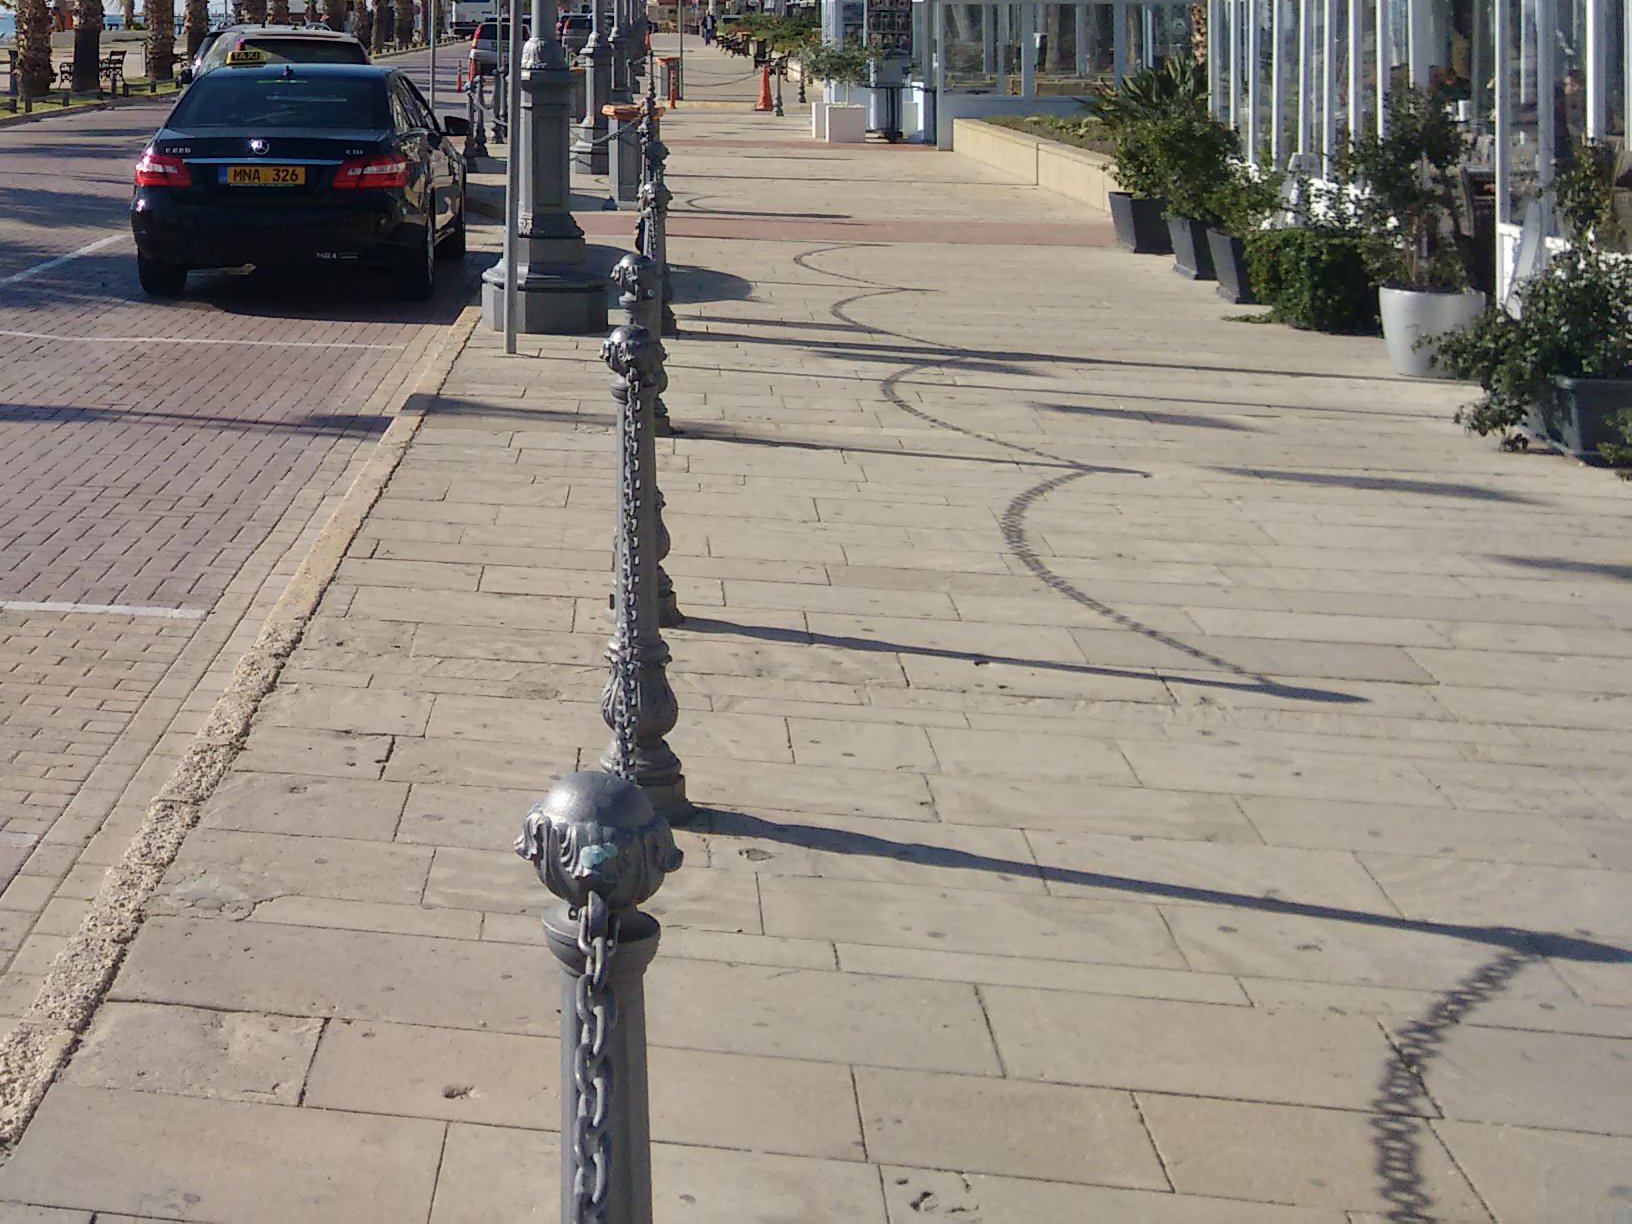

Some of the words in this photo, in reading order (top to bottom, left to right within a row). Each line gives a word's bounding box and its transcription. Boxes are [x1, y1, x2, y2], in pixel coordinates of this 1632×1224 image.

[233, 51, 260, 61] TAXI
[233, 167, 261, 182] MNA
[272, 167, 299, 182] 326
